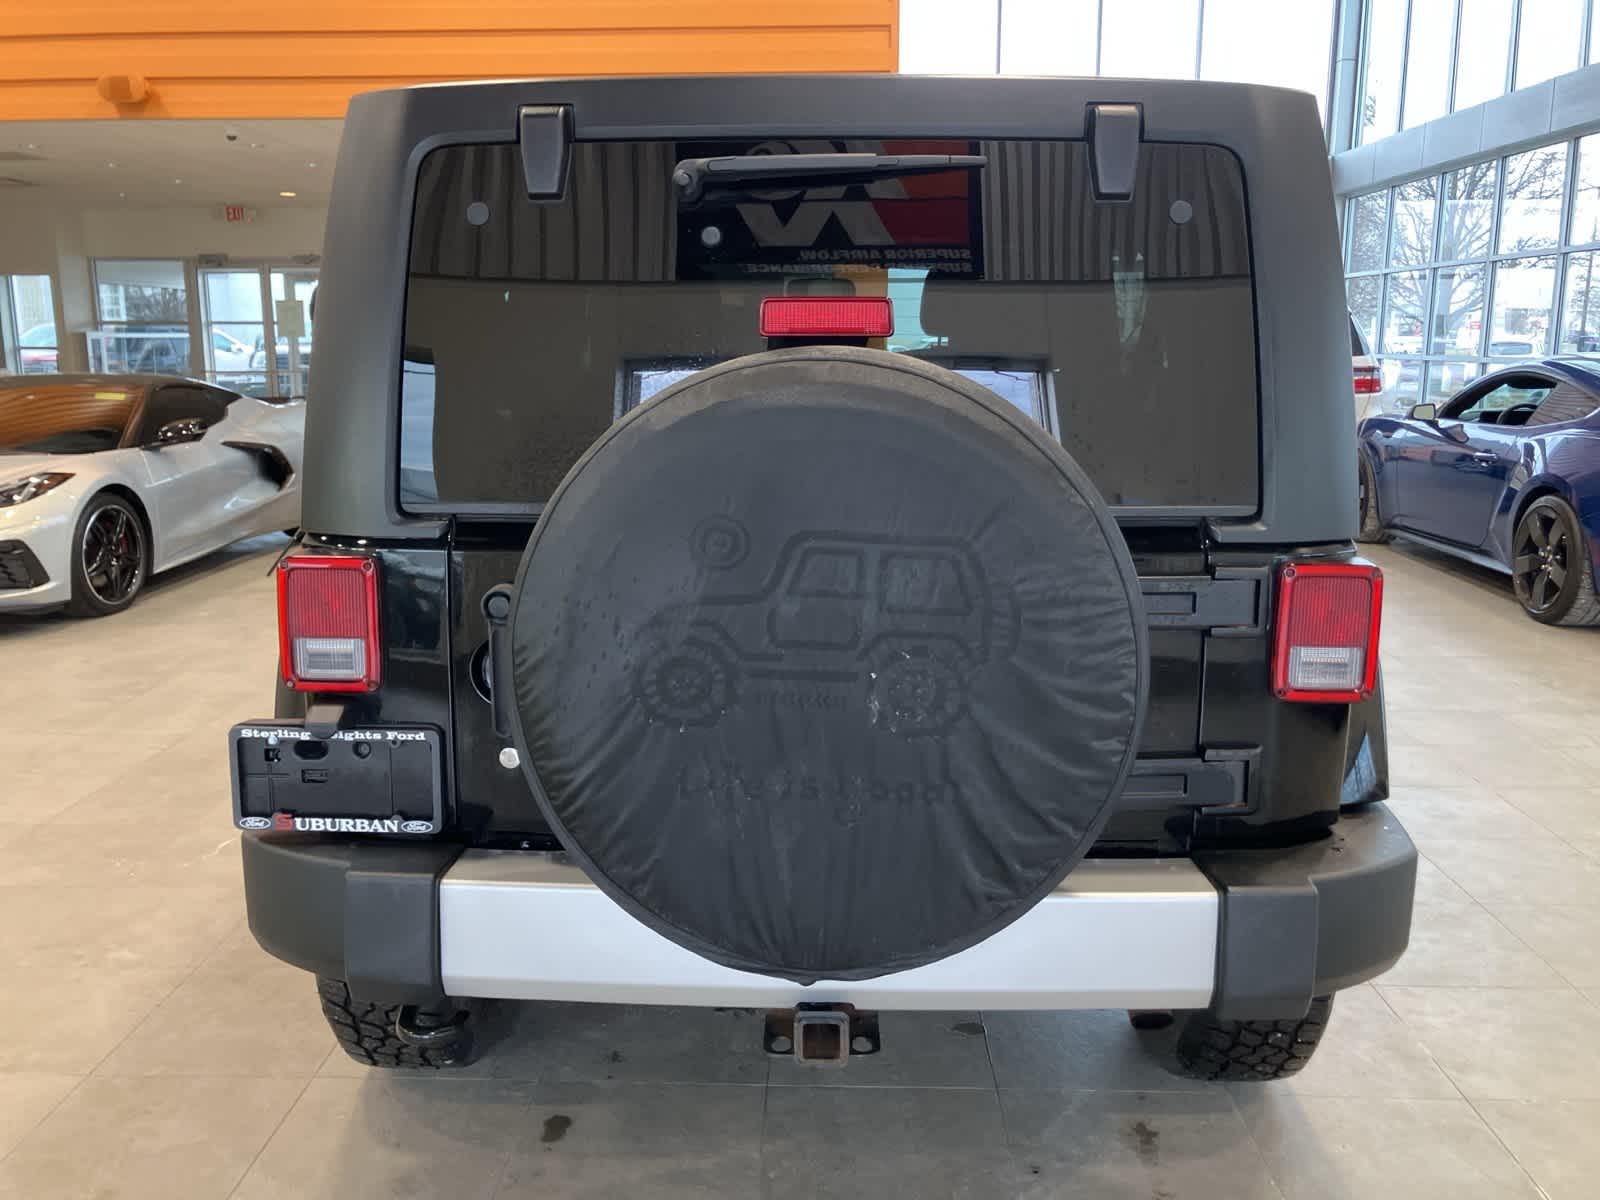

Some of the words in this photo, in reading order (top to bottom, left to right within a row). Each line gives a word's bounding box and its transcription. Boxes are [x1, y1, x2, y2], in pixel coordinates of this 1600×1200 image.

[240, 728, 312, 741] Sterling
[386, 731, 426, 741] Ford
[275, 813, 399, 833] SUBURBAN
